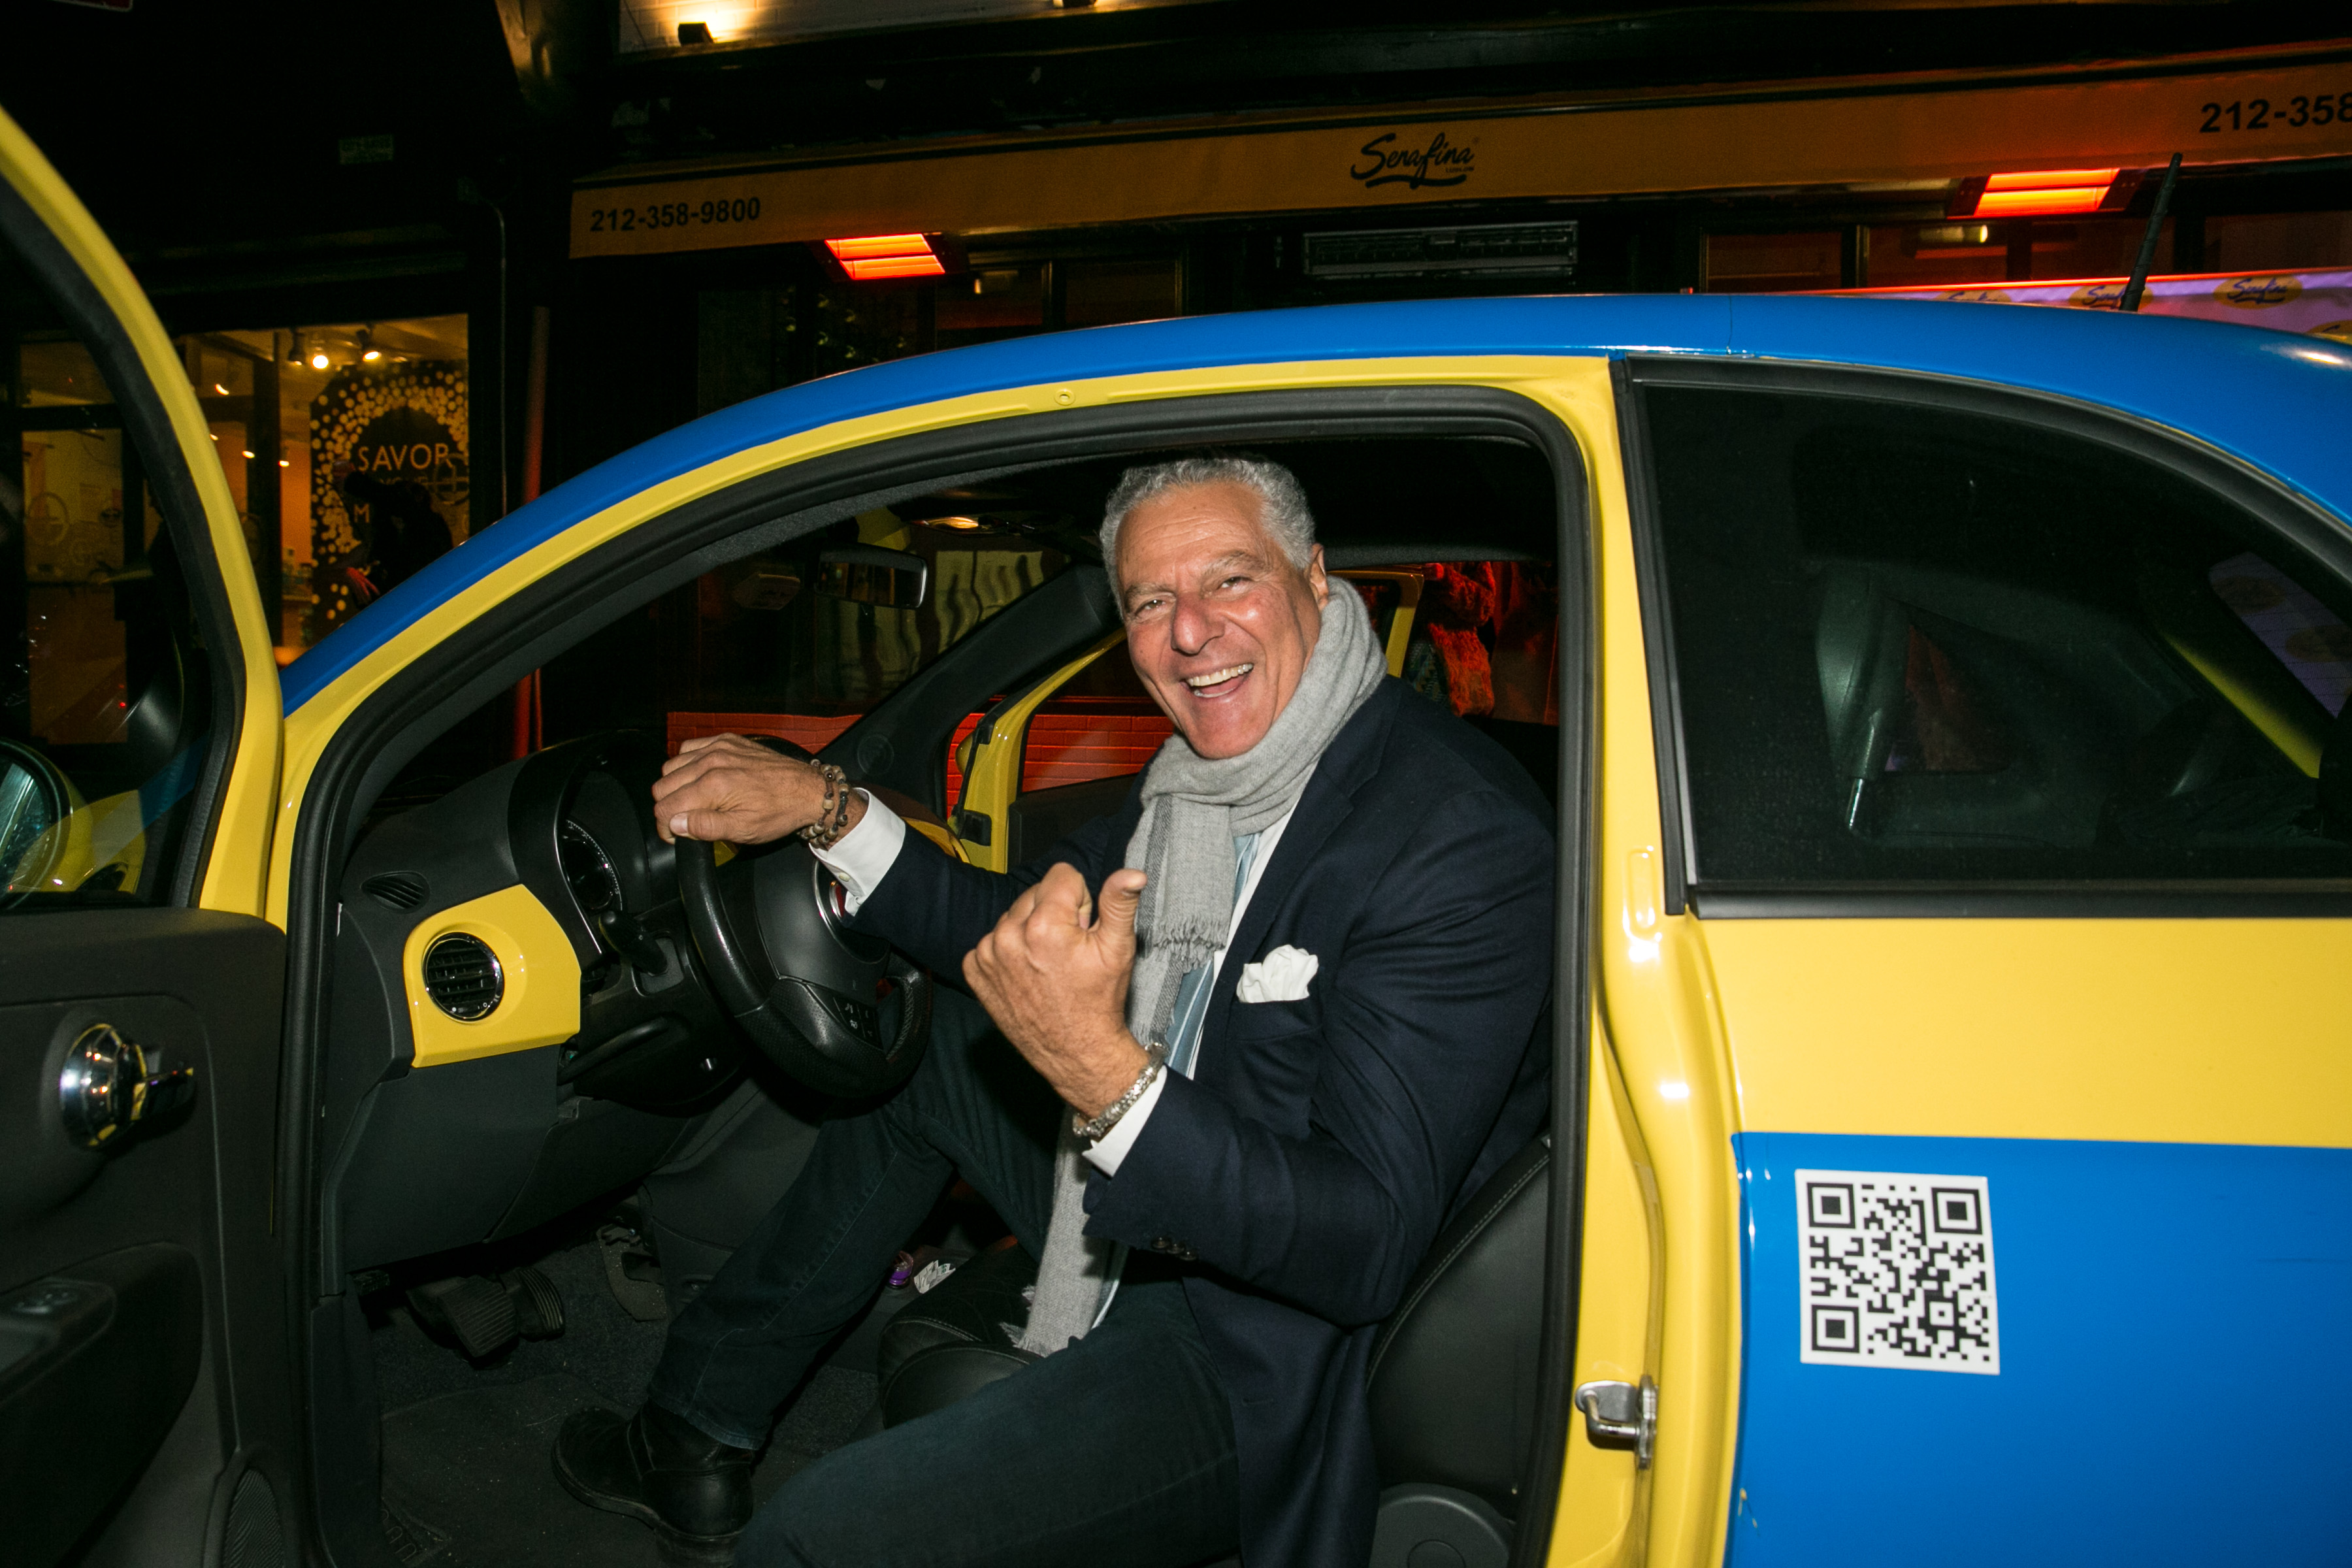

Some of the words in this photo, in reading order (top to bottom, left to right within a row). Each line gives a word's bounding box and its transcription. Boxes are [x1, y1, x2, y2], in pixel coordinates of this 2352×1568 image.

[1350, 132, 1475, 189] Serafina
[590, 197, 760, 231] 212-358-9800
[357, 442, 455, 472] SAVOR
